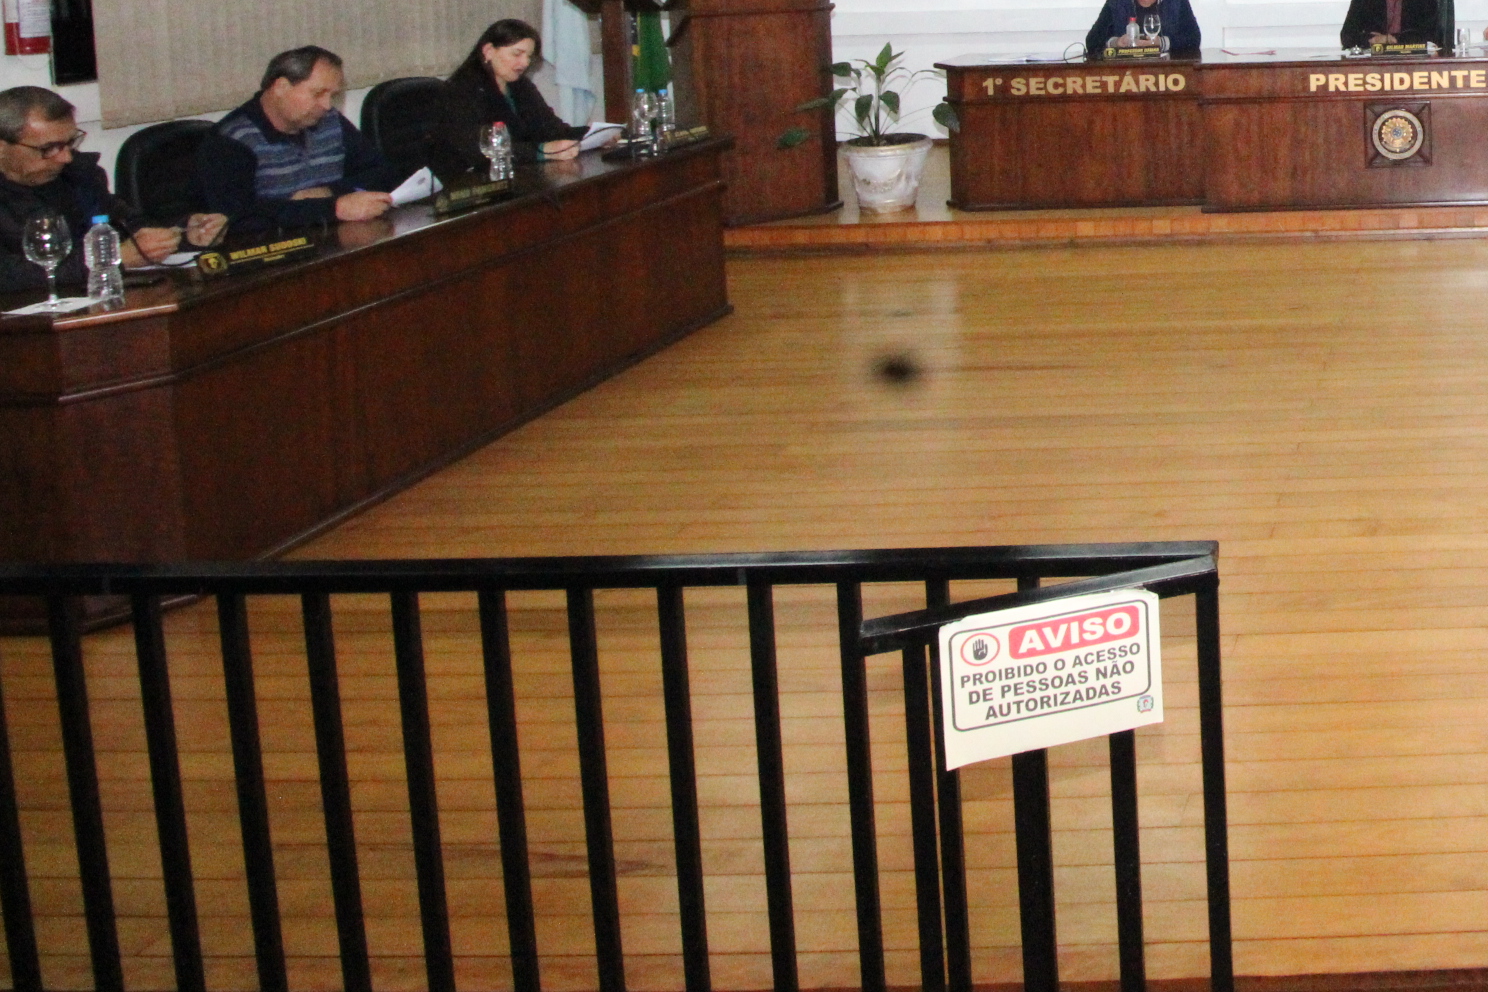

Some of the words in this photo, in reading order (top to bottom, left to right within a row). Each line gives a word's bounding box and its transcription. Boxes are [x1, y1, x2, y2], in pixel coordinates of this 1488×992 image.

[1010, 71, 1186, 96] SECRETÁRIO
[1309, 70, 1487, 92] PRESIDENTE
[1018, 612, 1132, 654] AVISO
[960, 661, 1048, 689] PROIBIDO
[1053, 658, 1066, 672] O
[1071, 642, 1141, 668] ACESSO
[968, 687, 993, 706] DE
[1000, 670, 1089, 699] PESSOAS
[1095, 660, 1135, 682] NÃO
[985, 680, 1122, 721] AUTORIZADAS
